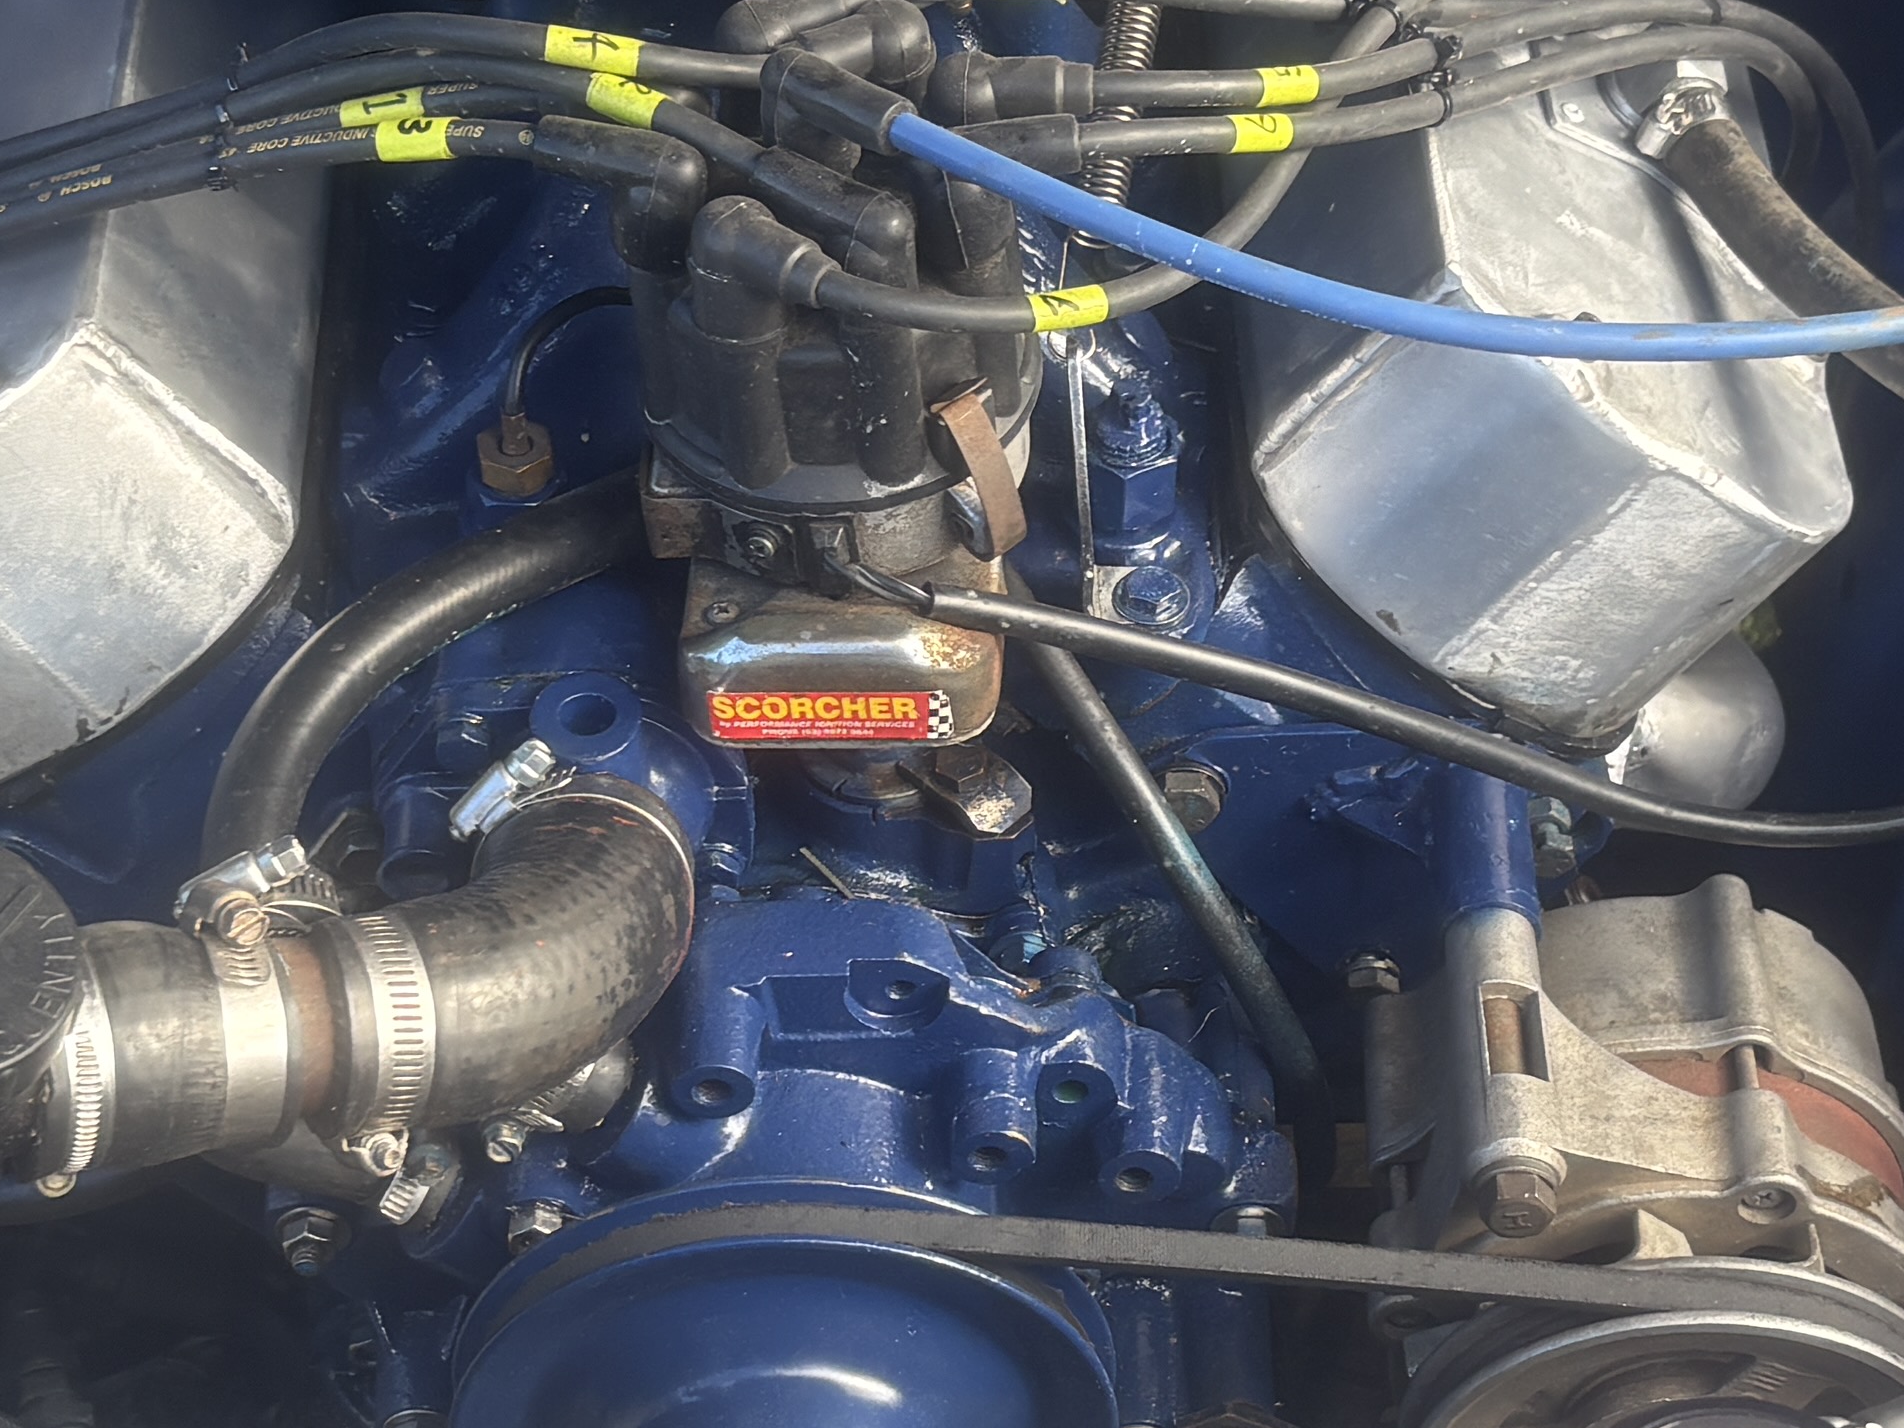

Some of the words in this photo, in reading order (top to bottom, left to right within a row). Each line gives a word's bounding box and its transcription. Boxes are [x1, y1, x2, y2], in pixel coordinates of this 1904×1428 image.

[572, 32, 620, 61] 4
[396, 118, 432, 135] 3
[445, 122, 485, 139] SUPE
[245, 136, 287, 154] CORE
[291, 127, 369, 149] INDUCTIVE
[59, 175, 113, 197] BOSCH
[712, 695, 919, 721] SCORCHER
[734, 720, 812, 729] PERFORMANCE
[814, 720, 862, 728] IGNITION
[864, 720, 915, 729] SERVICES
